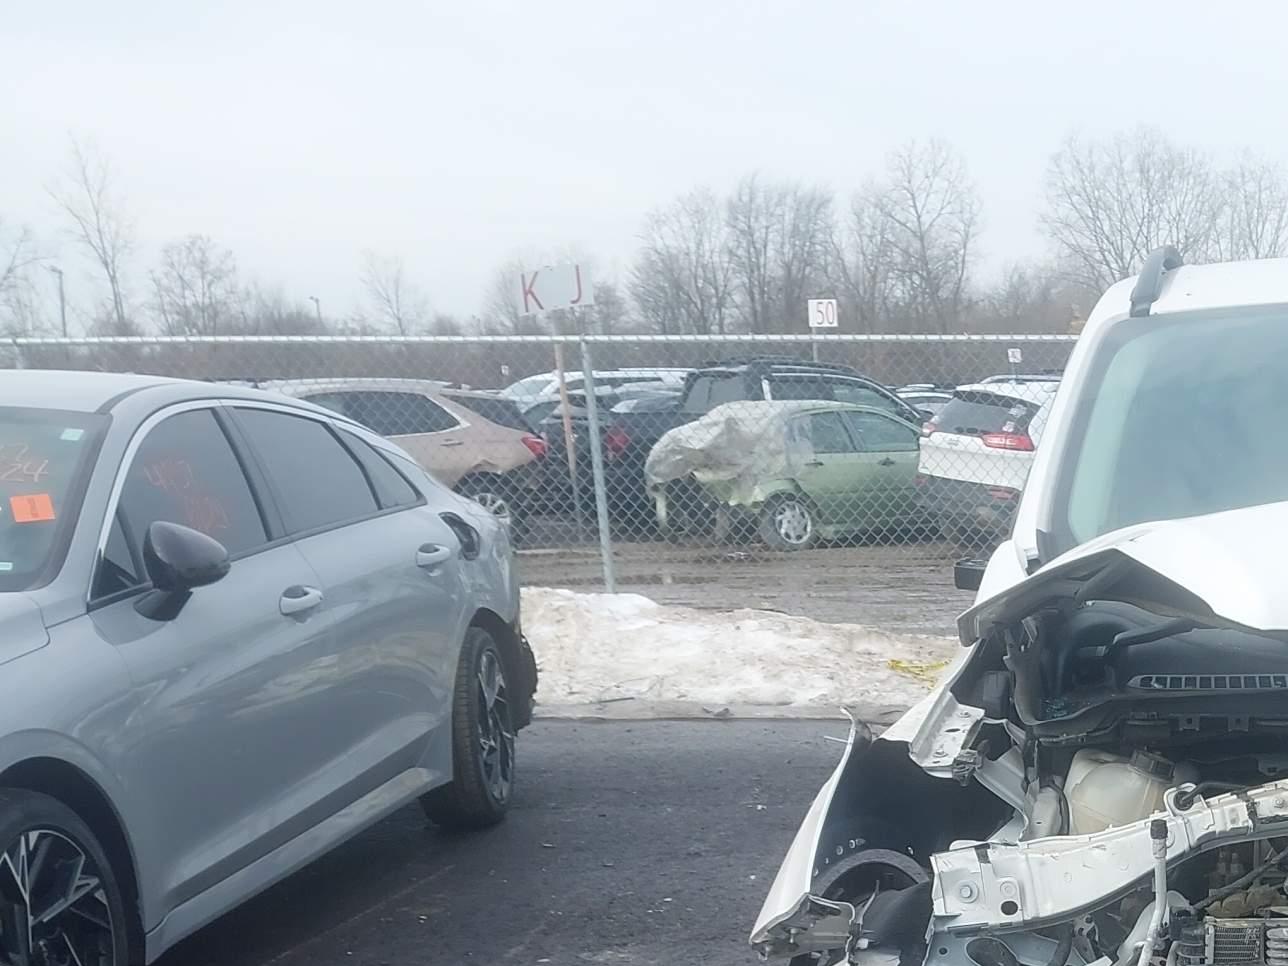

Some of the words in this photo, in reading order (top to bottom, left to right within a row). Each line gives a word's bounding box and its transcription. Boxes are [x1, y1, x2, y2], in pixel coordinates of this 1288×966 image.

[520, 271, 545, 313] K
[570, 264, 583, 305] J
[816, 301, 835, 325] 50
